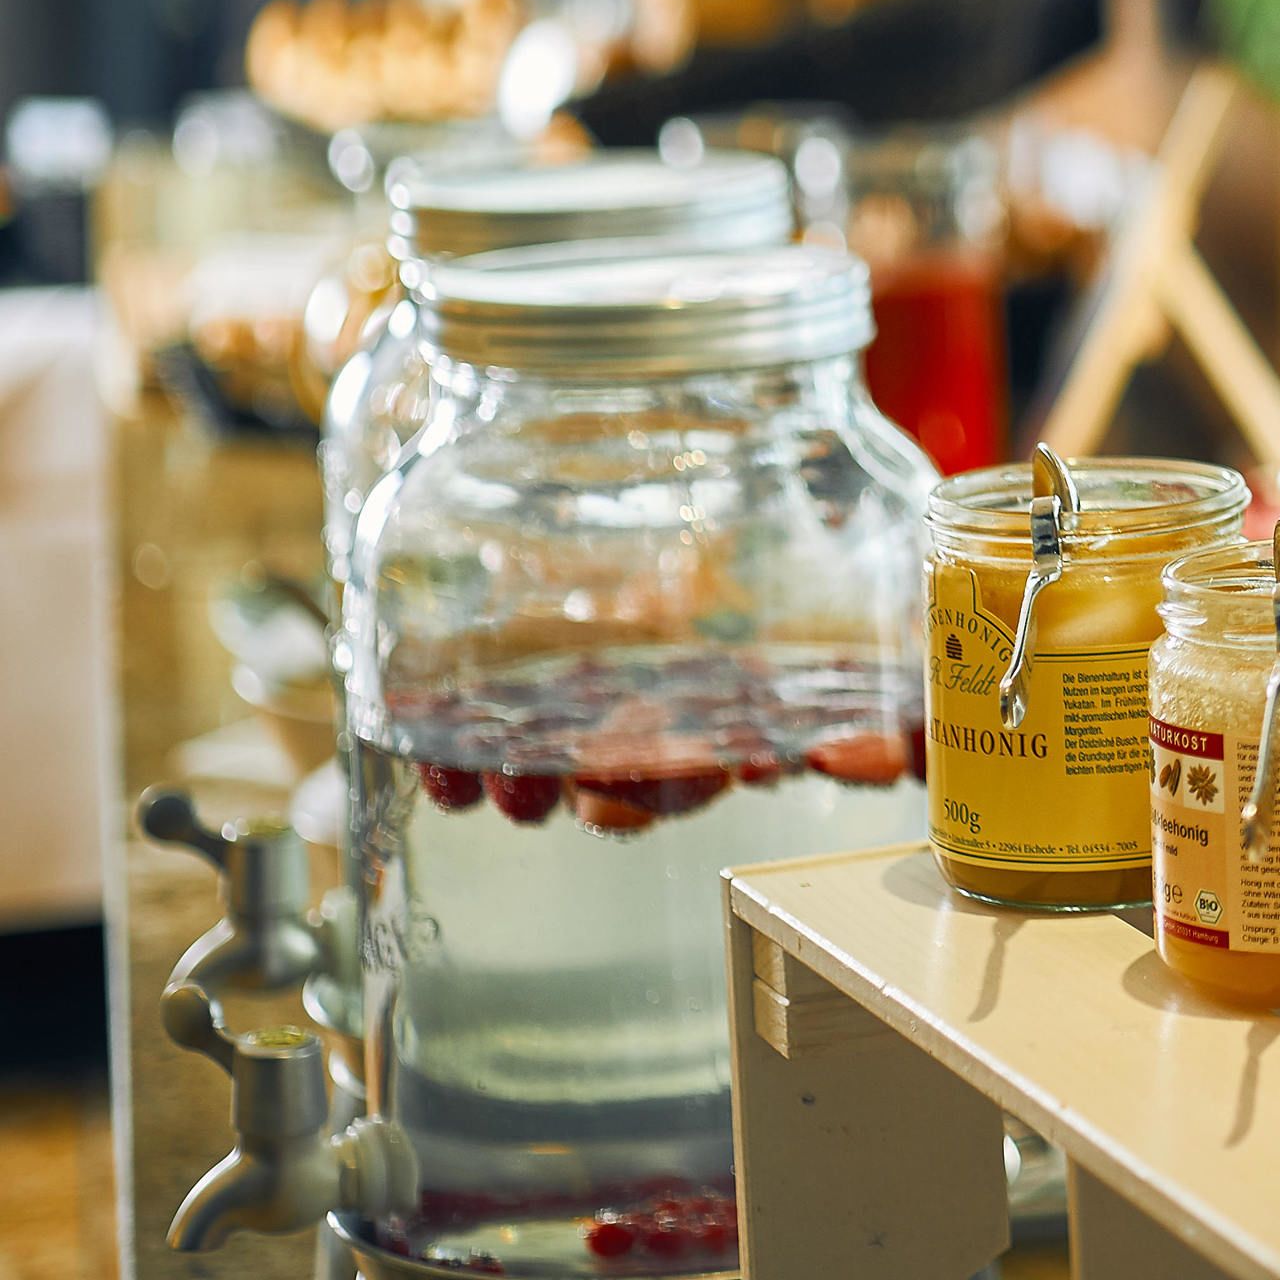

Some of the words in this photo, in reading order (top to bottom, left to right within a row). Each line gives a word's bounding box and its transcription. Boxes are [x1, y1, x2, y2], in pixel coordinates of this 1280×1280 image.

[944, 663, 997, 696] Feldt
[1062, 673, 1075, 683] Die
[1133, 670, 1142, 679] ist
[1063, 687, 1089, 696] Nutzen
[1090, 686, 1099, 695] im
[1101, 684, 1126, 696] kargen
[1101, 700, 1111, 708] Im
[1065, 739, 1077, 748] Der
[1079, 751, 1115, 762] Grundlage
[943, 797, 982, 834] 500g
[1240, 864, 1259, 872] nicht
[1240, 880, 1262, 888] Honig
